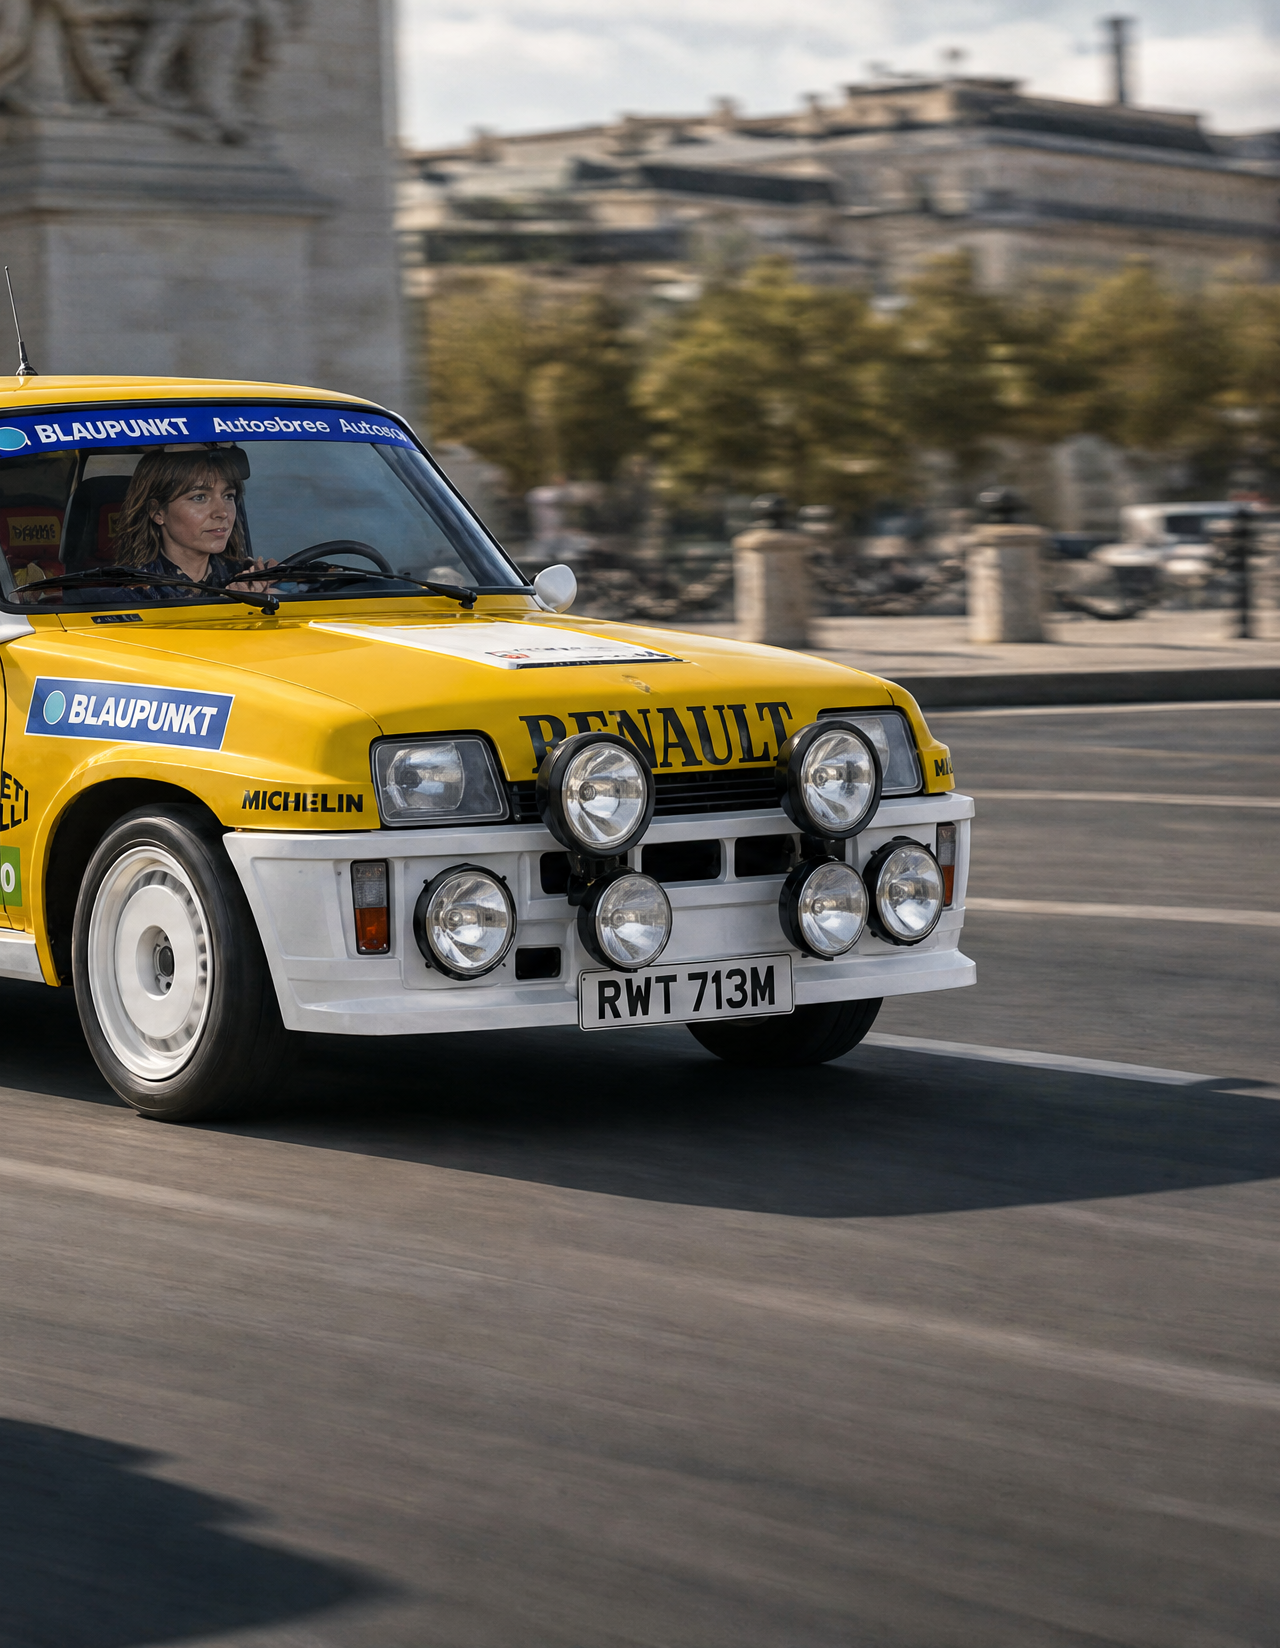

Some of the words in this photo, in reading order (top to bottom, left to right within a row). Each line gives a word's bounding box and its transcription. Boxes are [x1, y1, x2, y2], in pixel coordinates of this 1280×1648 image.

[34, 417, 190, 444] BLAUPUNKT
[212, 416, 331, 434] Autosbree
[67, 693, 219, 736] BLAUPUNKT
[241, 790, 364, 813] MICHELIN
[597, 974, 678, 1020] RWT
[687, 965, 776, 1012] 713M
